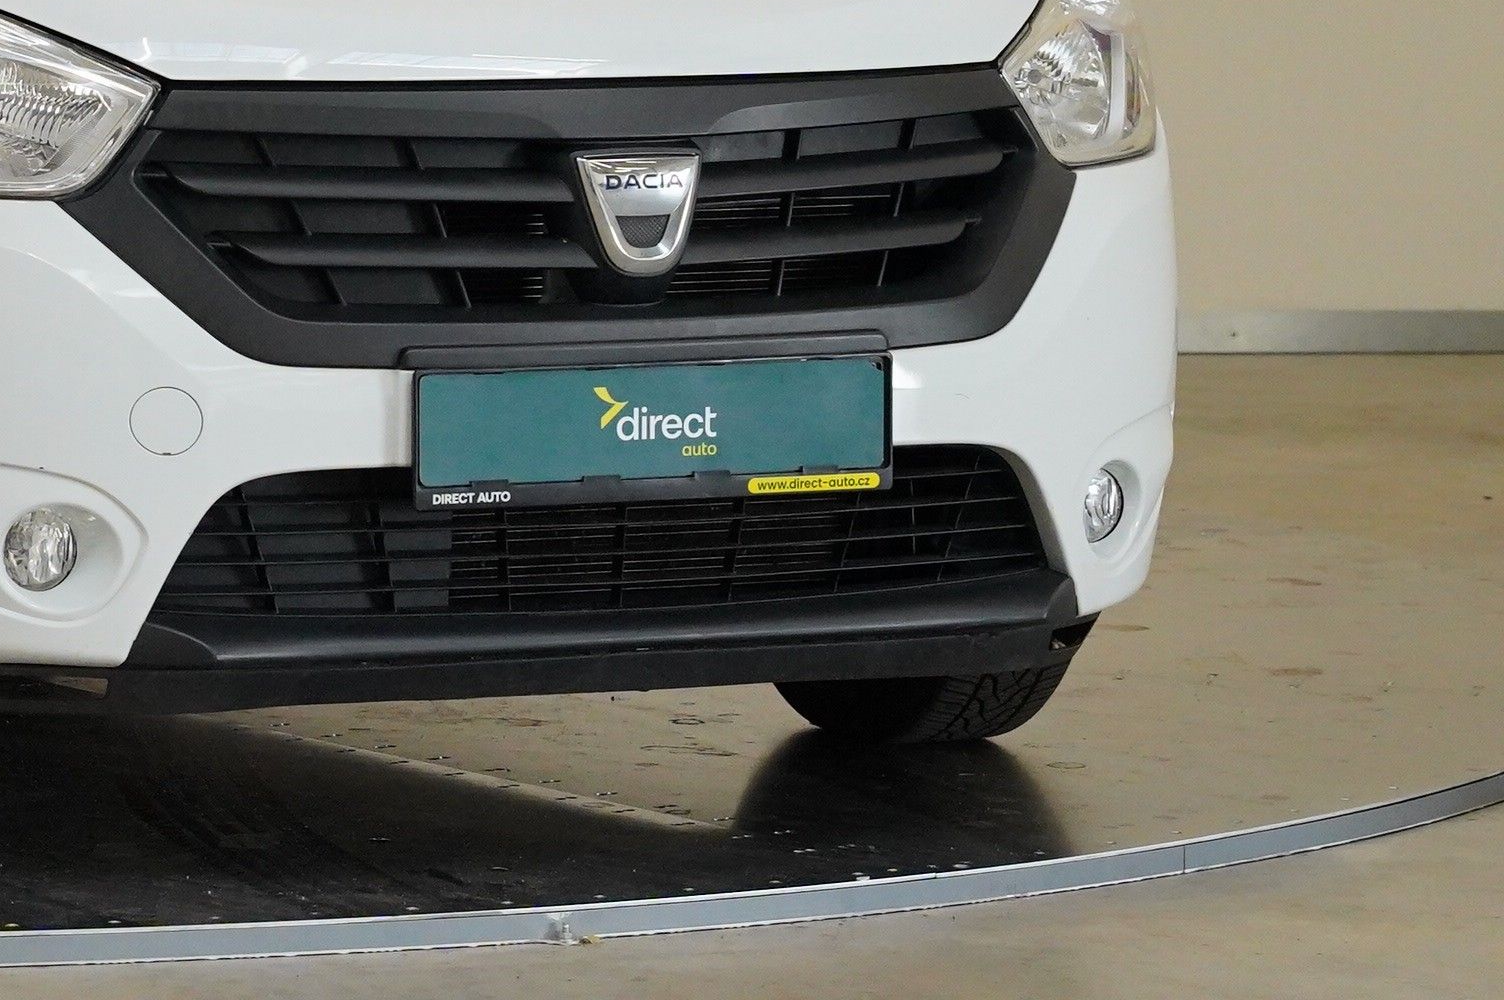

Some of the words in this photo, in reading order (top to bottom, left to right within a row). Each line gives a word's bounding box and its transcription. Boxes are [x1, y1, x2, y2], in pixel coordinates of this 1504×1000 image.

[605, 174, 683, 190] DACIA
[616, 407, 717, 441] direct
[682, 442, 717, 456] auto
[757, 476, 870, 490] www.direct-auto.cz
[432, 492, 475, 505] DIRECT
[477, 491, 511, 503] AUTO
